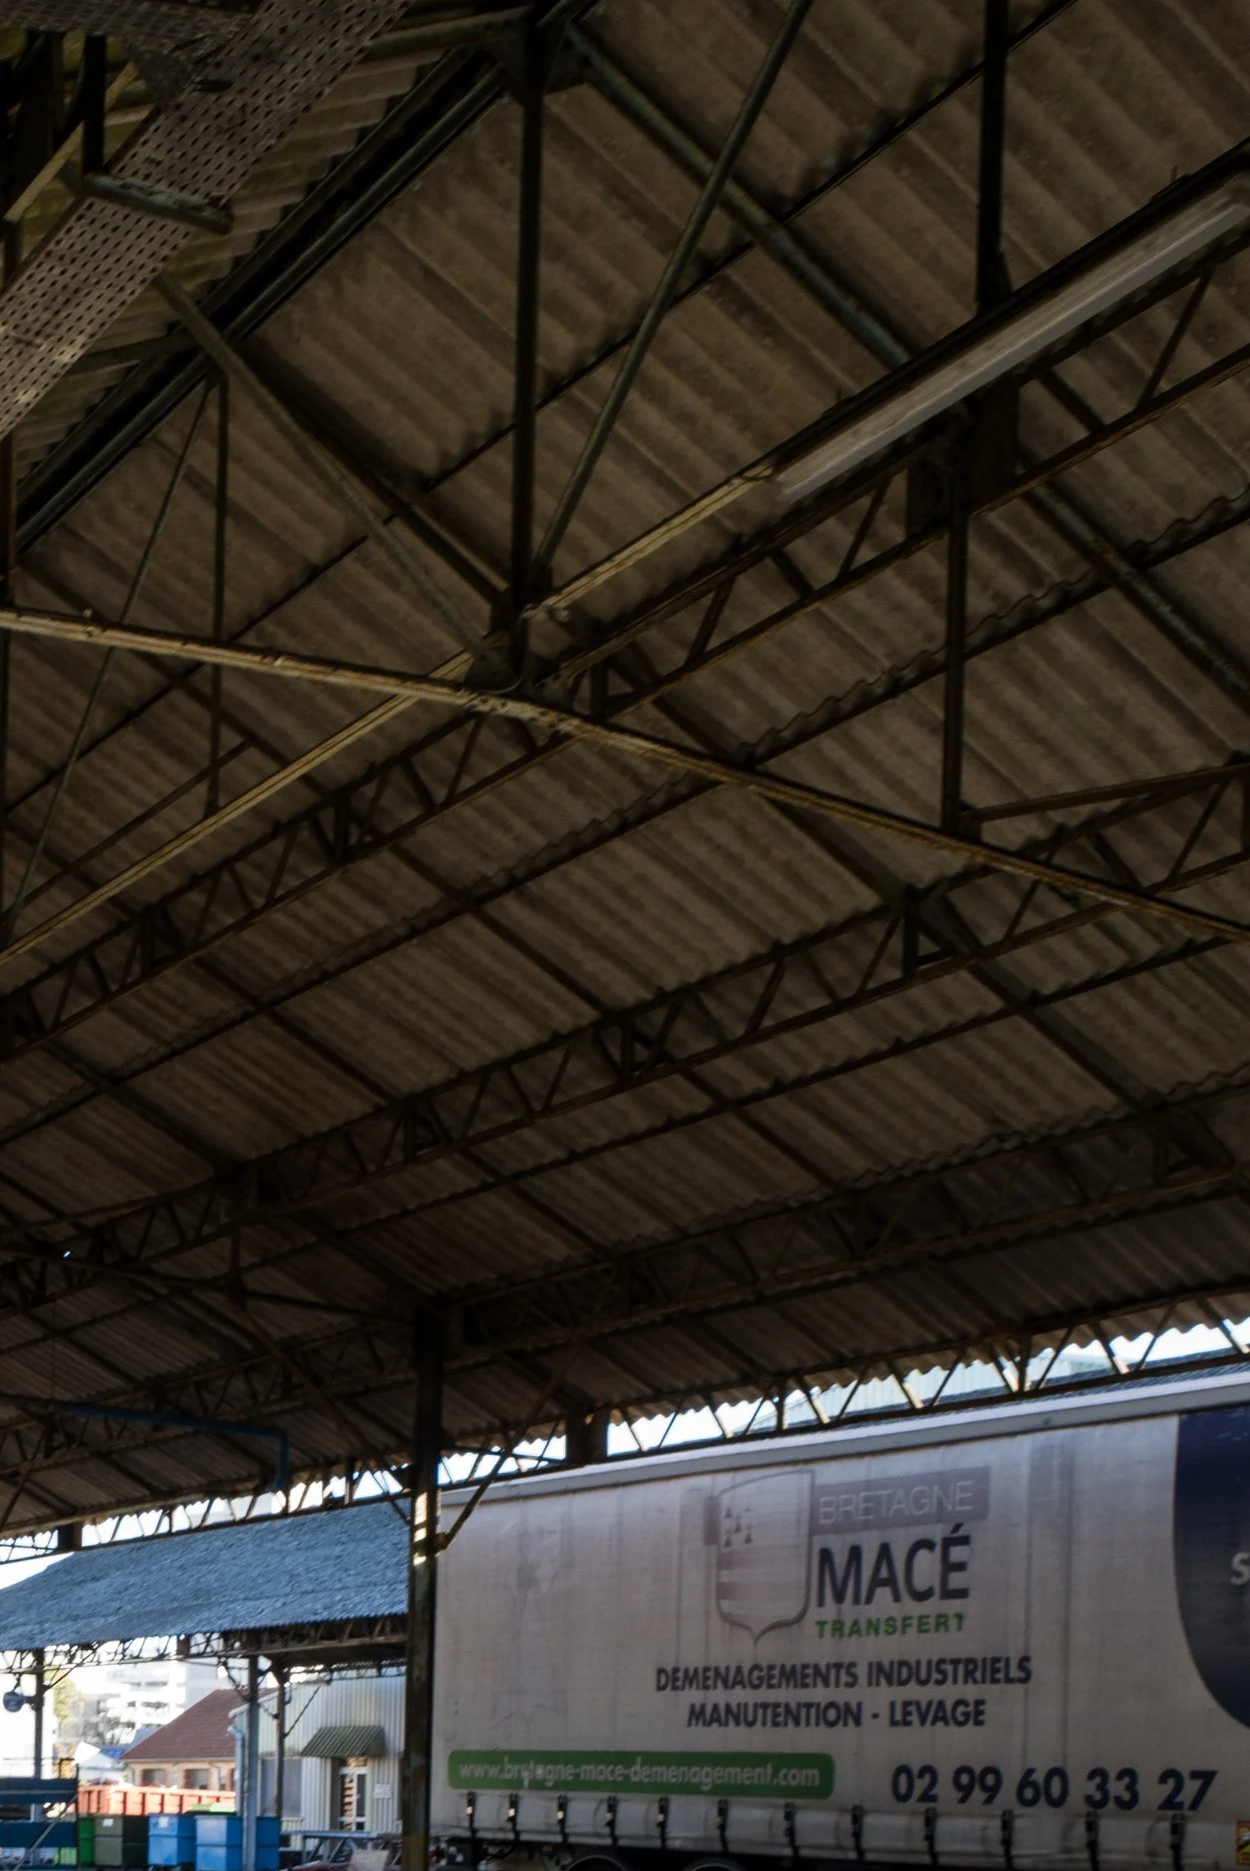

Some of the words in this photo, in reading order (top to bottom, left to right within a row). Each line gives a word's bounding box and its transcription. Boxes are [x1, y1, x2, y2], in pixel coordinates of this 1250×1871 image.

[818, 1481, 974, 1525] BRETAGNE
[816, 1522, 971, 1608] MACÉ
[815, 1612, 965, 1639] TRANSFERT
[656, 1661, 858, 1692] DEMENAGEMENTS
[867, 1655, 1032, 1686] INDUSTRIELS
[687, 1702, 862, 1728] MANUTENTION
[889, 1699, 986, 1727] LEVAGE
[892, 1764, 938, 1803] 02
[953, 1765, 1002, 1804] 99
[1016, 1767, 1069, 1808] 60
[1083, 1767, 1139, 1810] 33
[1157, 1768, 1218, 1811] 27
